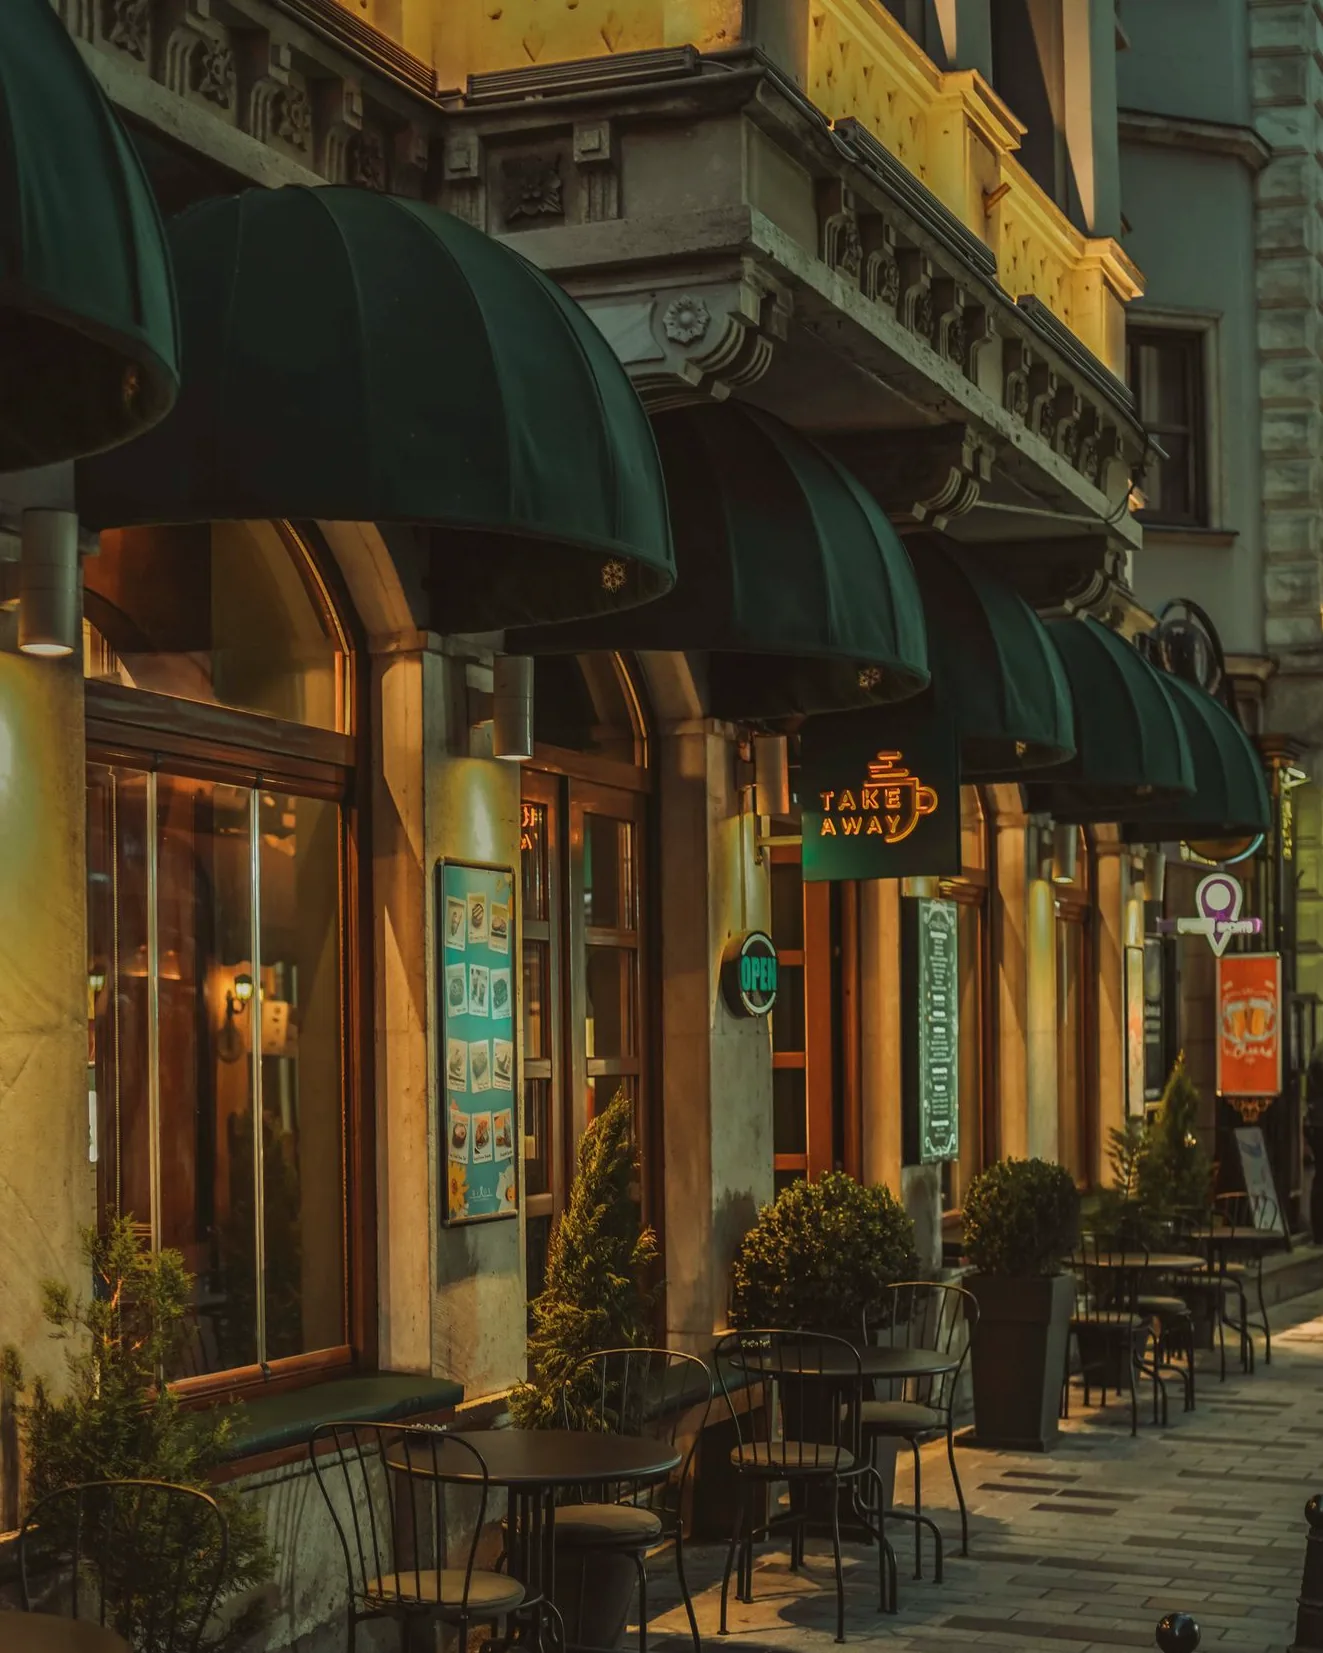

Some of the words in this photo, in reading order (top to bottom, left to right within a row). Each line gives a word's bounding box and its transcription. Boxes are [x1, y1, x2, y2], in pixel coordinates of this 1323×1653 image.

[820, 788, 901, 811] TAKE
[821, 815, 901, 836] AWAY
[741, 956, 777, 992] OPEN
